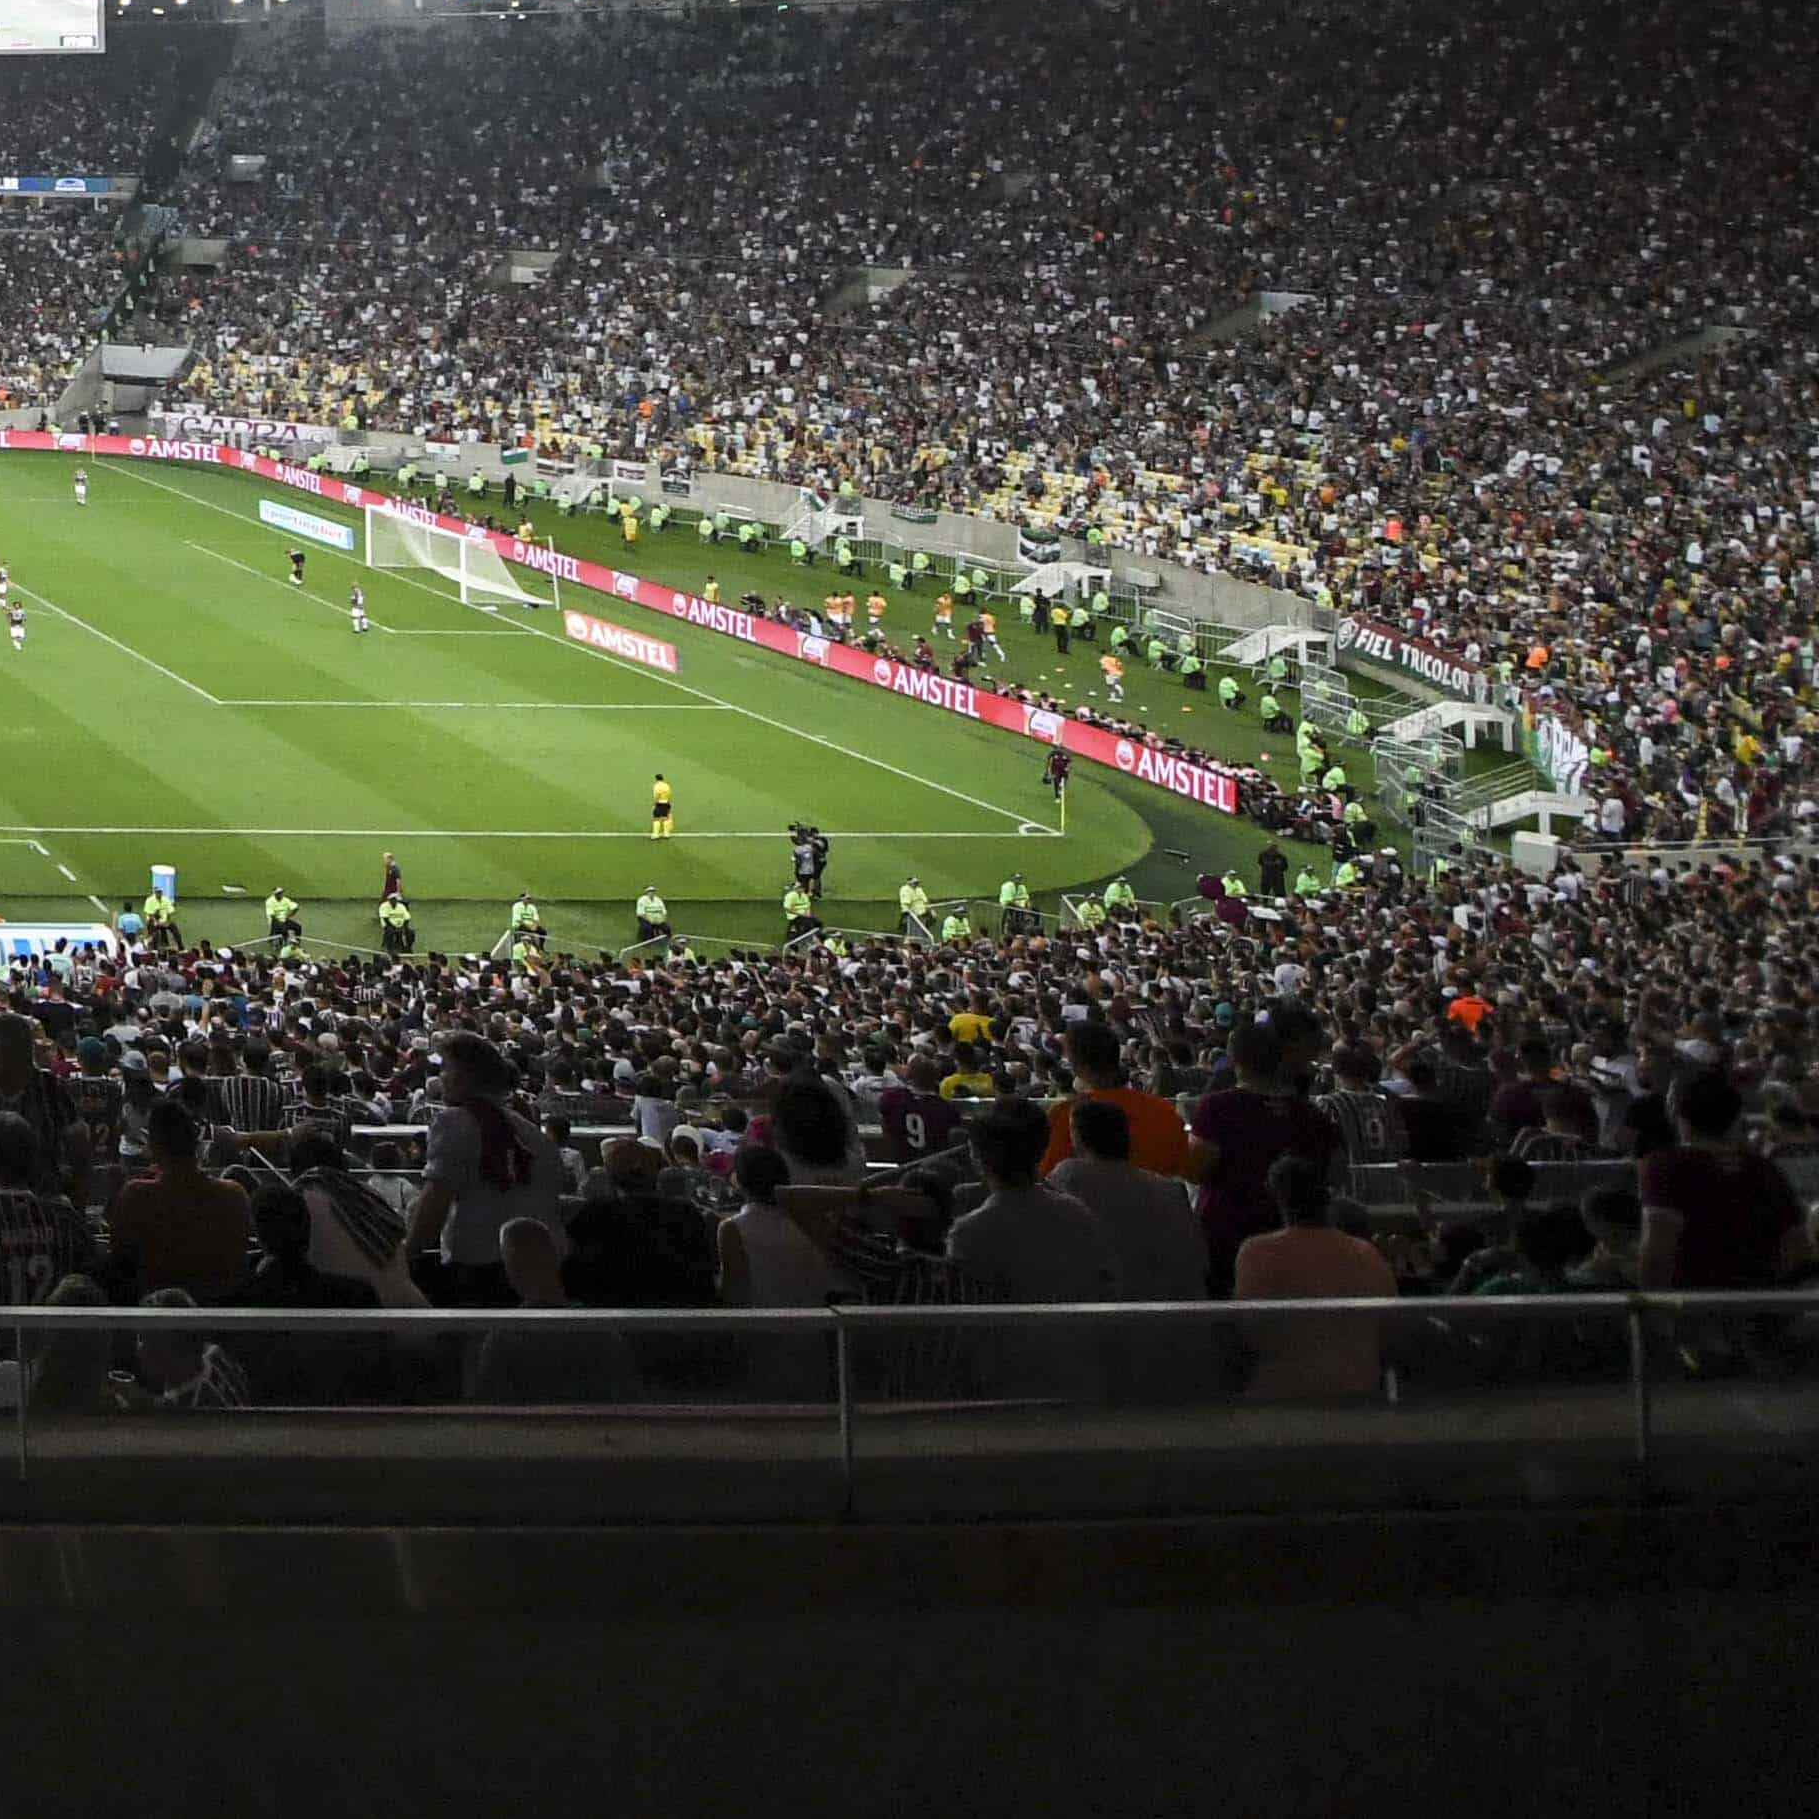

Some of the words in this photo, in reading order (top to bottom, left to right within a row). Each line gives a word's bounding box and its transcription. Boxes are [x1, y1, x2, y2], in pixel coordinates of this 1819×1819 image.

[148, 439, 221, 462] AMSTEL
[283, 466, 322, 494] AMSTEL
[525, 544, 581, 582] AMSTEL
[688, 597, 757, 642] AMSTEL
[590, 622, 674, 670] AMSTEL
[1355, 628, 1393, 661] FIEL
[1400, 643, 1471, 696] TRICOLOR
[893, 665, 980, 718] AMSTEL
[1136, 748, 1232, 813] AMSTEL
[905, 1113, 926, 1149] 9
